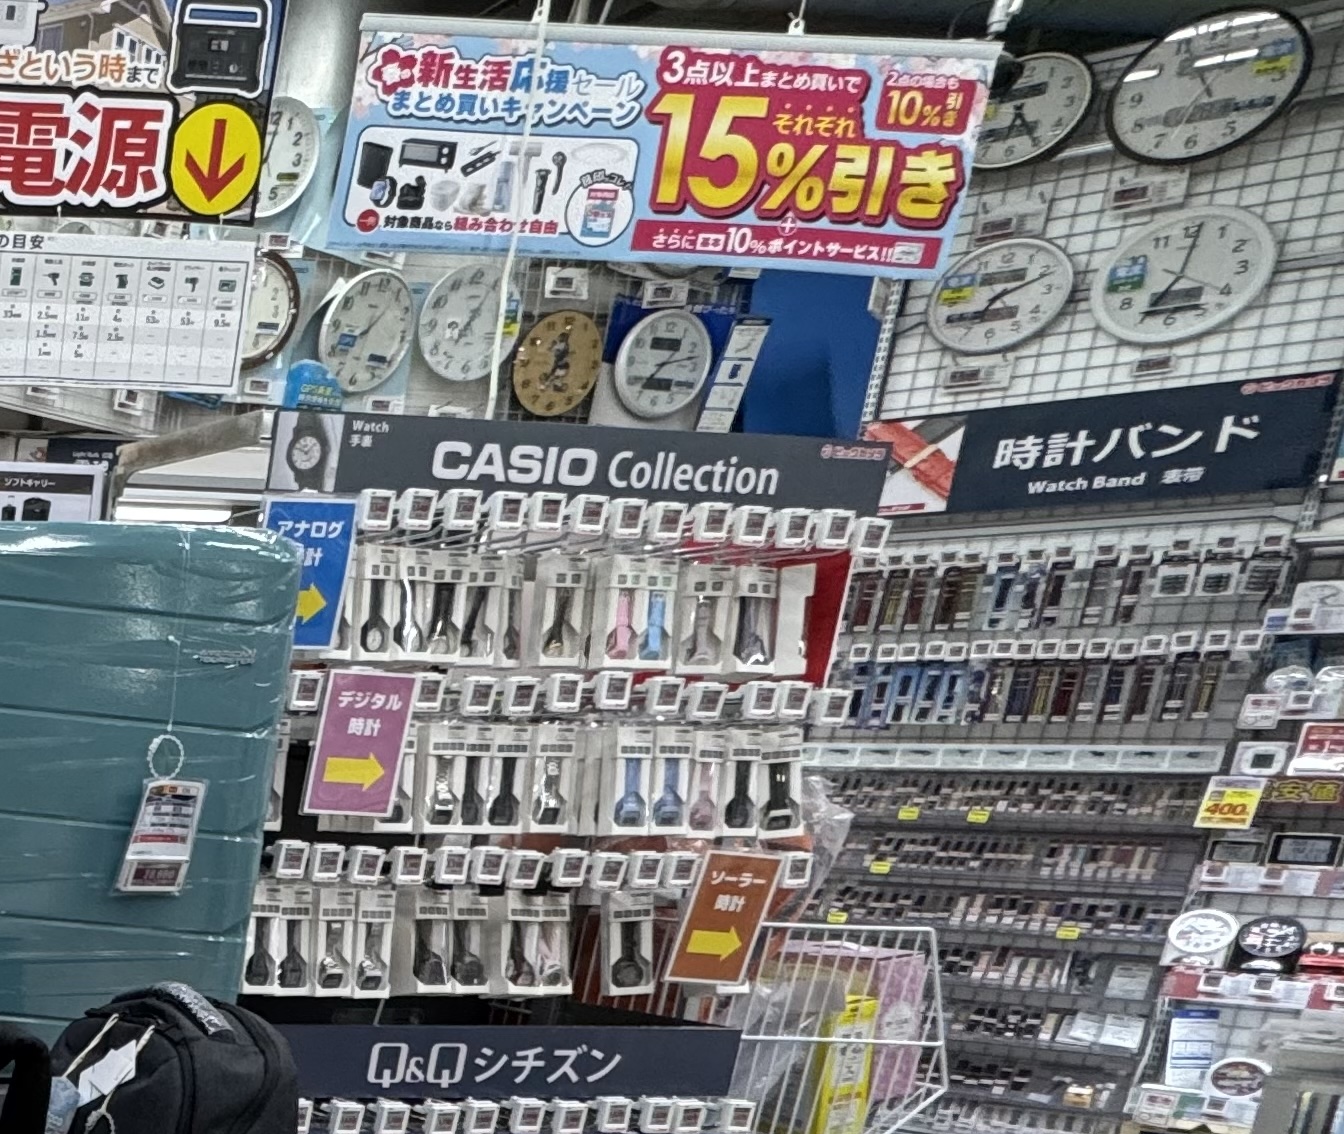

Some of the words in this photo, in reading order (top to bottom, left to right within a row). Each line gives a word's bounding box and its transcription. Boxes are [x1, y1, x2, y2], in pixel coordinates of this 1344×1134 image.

[662, 51, 862, 93] 3点以上まとめ買いで
[772, 112, 857, 138] それぞれ
[652, 93, 956, 220] 15%引き
[352, 420, 390, 435] Watch
[992, 415, 1261, 470] 時計バンド
[431, 441, 597, 487] CASIO
[609, 451, 779, 496] Collection
[1027, 476, 1088, 495] Watch
[1093, 471, 1147, 489] Band
[277, 520, 344, 539] アナログ
[337, 690, 403, 711] デジタル
[347, 716, 382, 738] 時計
[711, 871, 767, 888] ソーラー
[473, 1044, 622, 1084] シチズン
